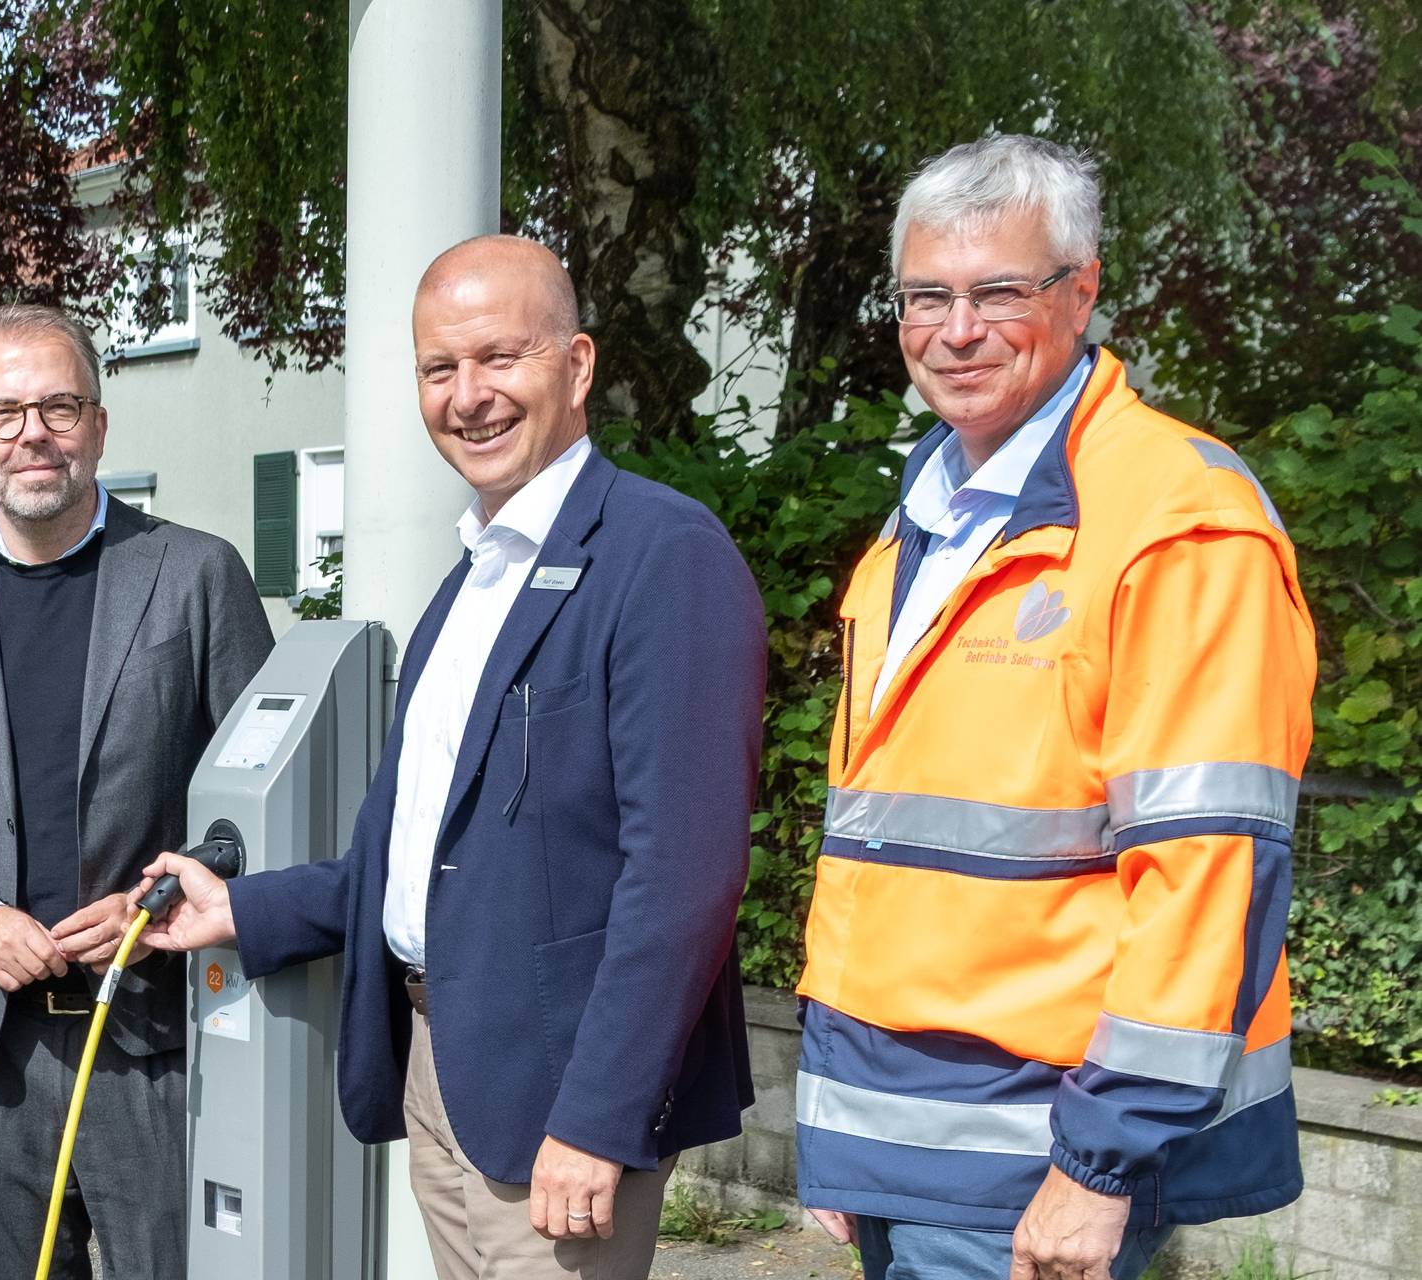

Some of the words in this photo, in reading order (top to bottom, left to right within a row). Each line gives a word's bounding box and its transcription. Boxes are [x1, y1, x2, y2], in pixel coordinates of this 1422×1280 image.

[957, 636, 1009, 649] Technische
[965, 651, 1007, 664] Betriebe
[209, 971, 221, 986] 22
